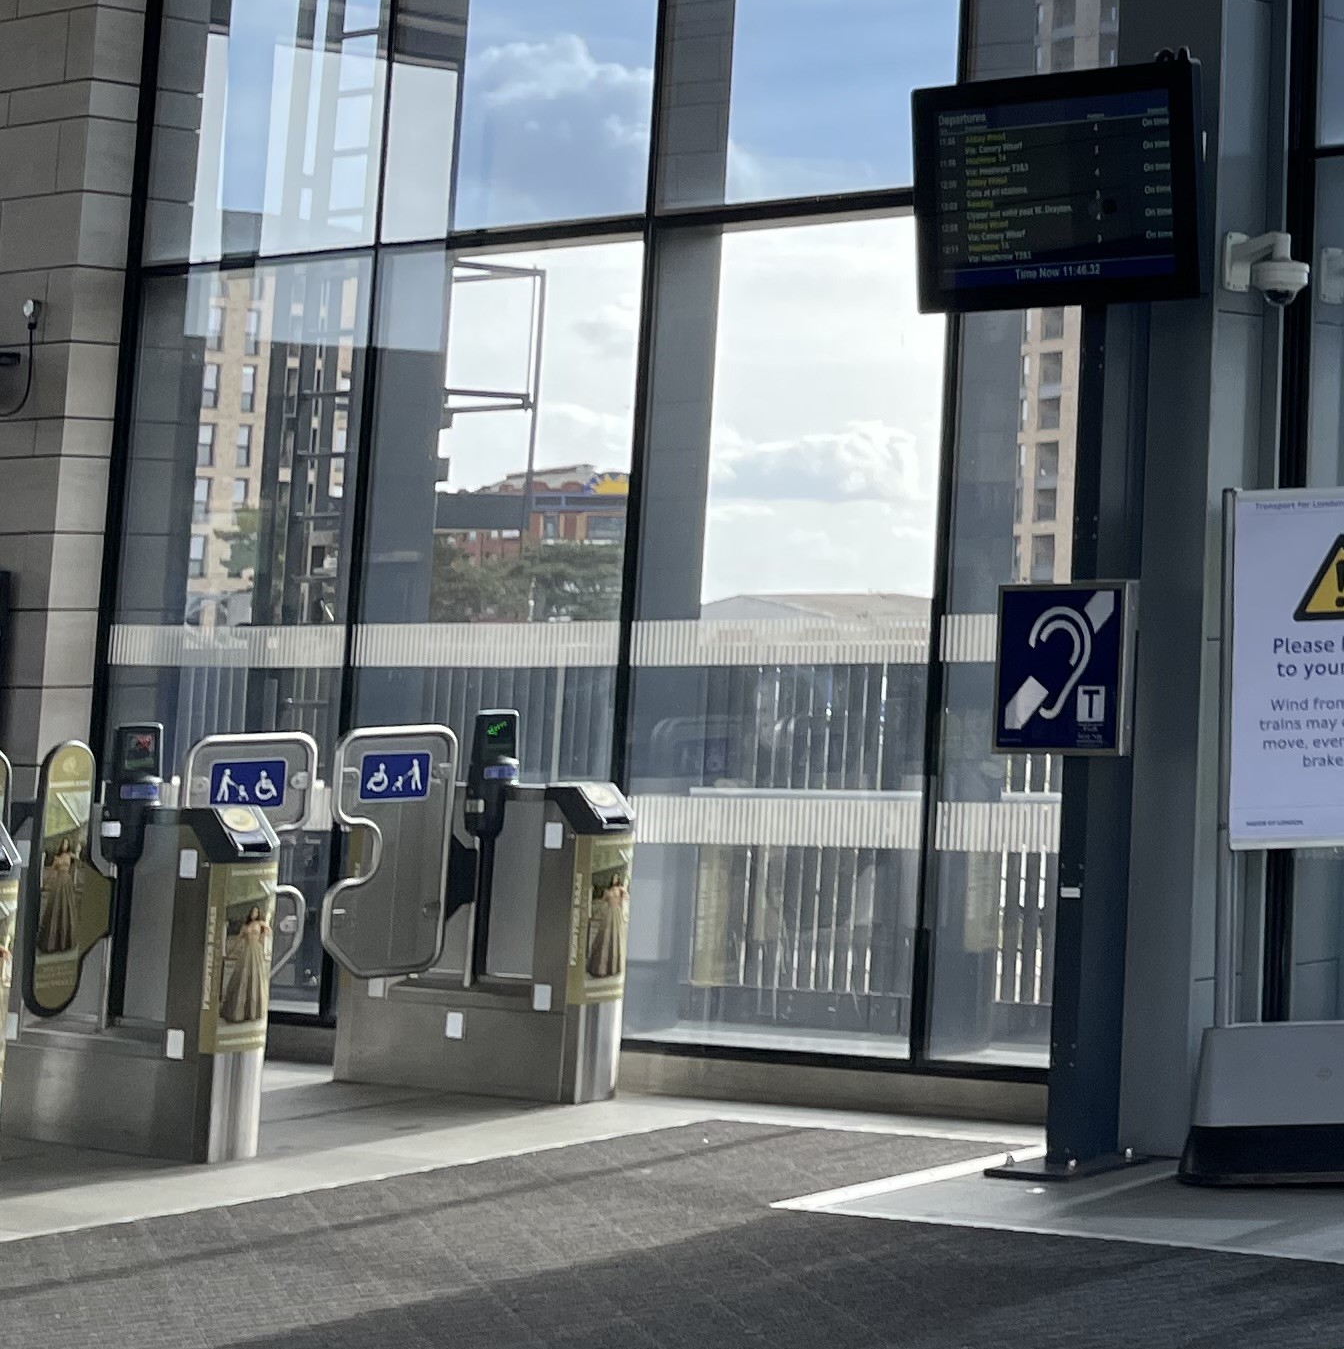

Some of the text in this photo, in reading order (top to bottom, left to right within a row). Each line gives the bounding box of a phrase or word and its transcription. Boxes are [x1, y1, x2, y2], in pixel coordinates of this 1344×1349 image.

[1015, 268, 1037, 280] Time
[1039, 267, 1060, 278] Now
[1273, 637, 1335, 654] Please
[1276, 662, 1297, 677] to
[1083, 689, 1100, 718] T
[1271, 698, 1309, 712] Wind
[1259, 717, 1301, 731] trains
[1306, 718, 1337, 732] may
[1263, 738, 1308, 750] move,
